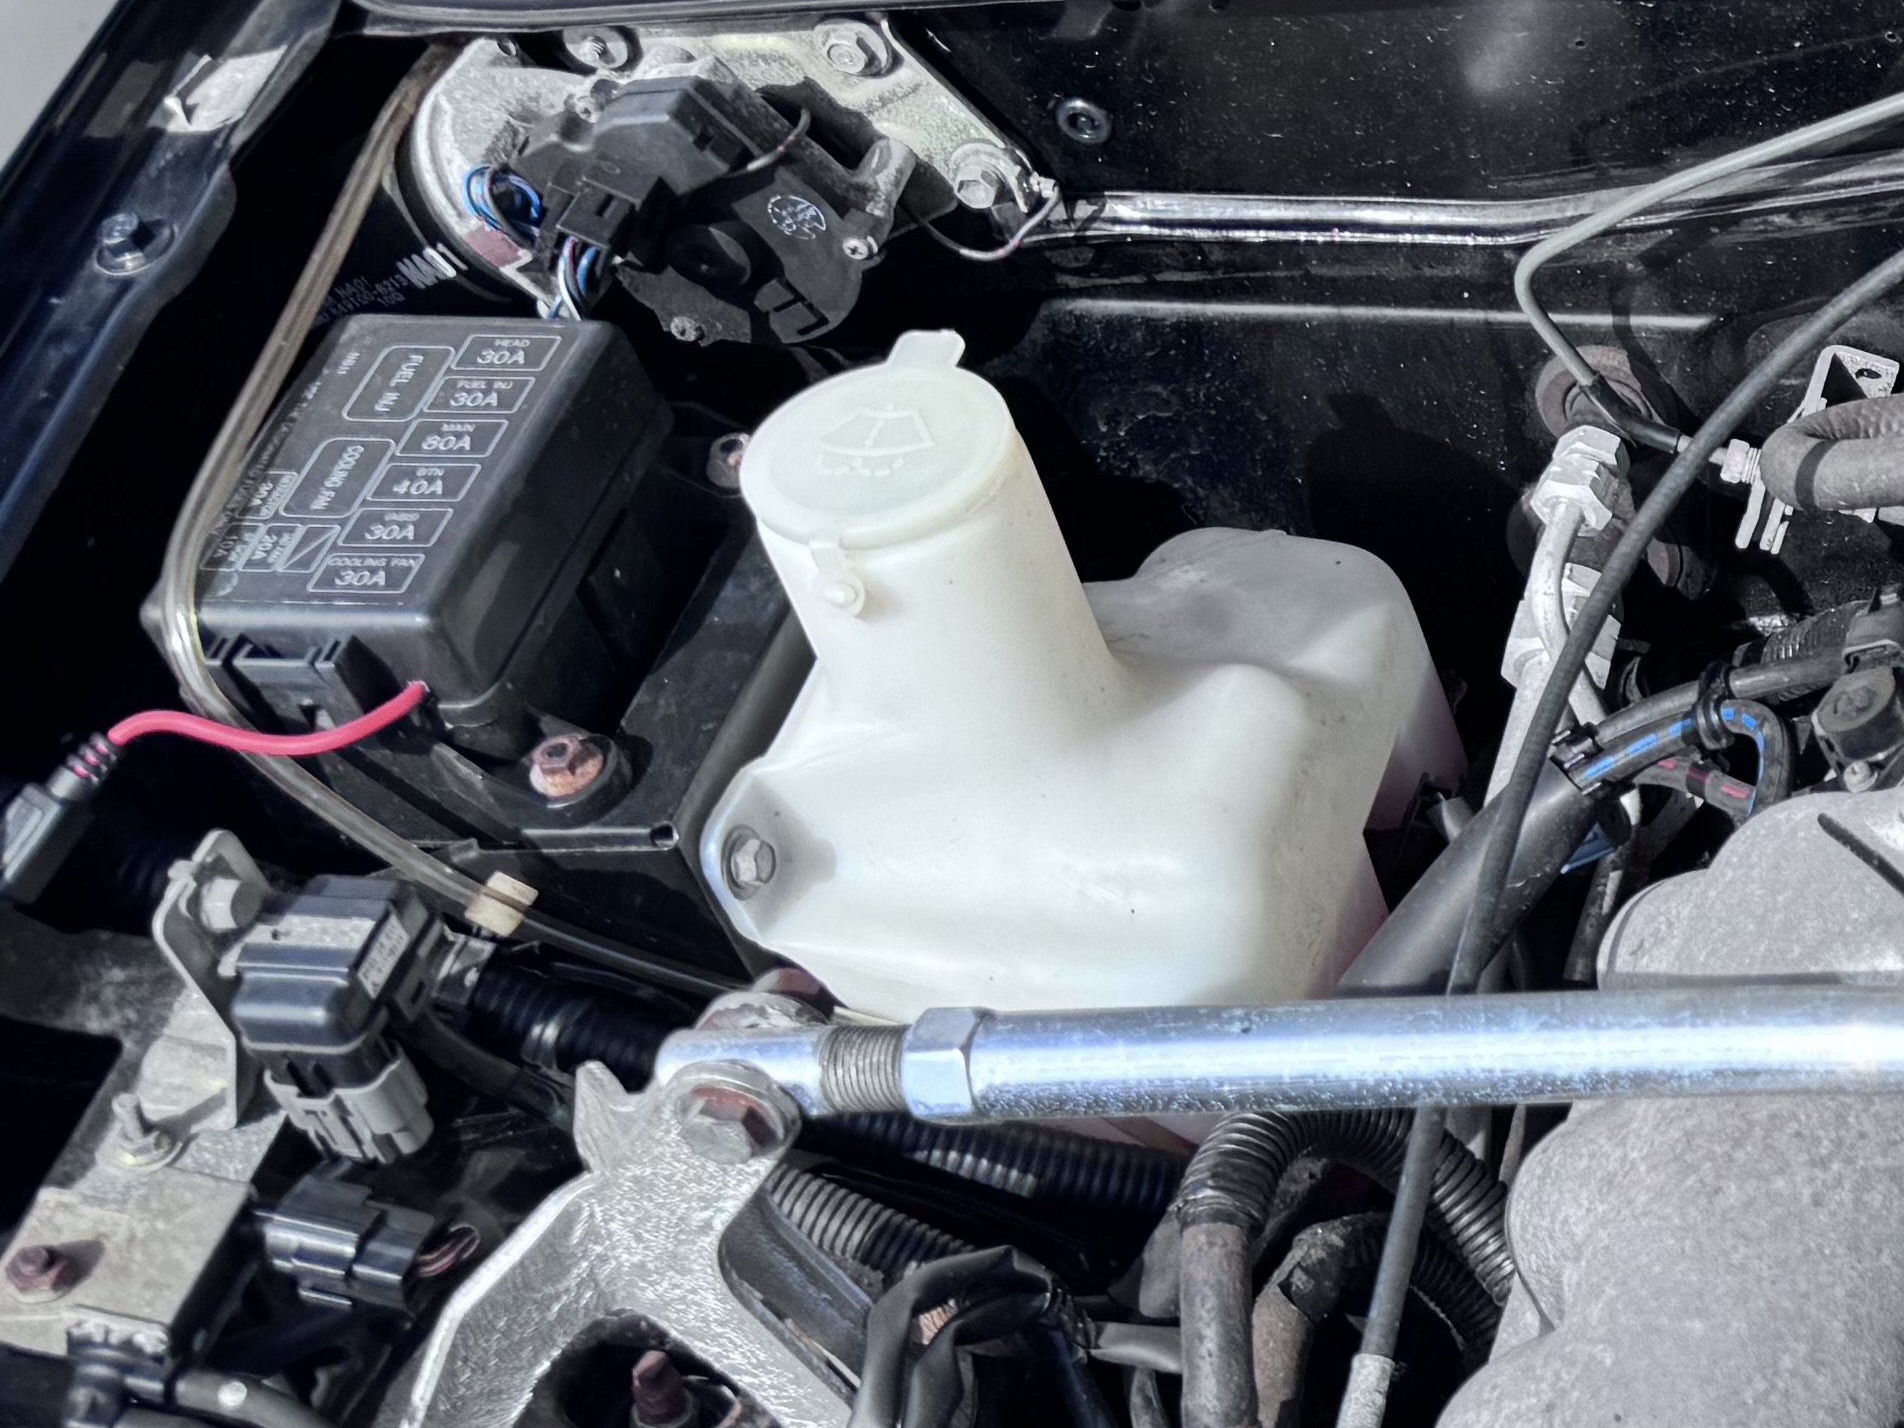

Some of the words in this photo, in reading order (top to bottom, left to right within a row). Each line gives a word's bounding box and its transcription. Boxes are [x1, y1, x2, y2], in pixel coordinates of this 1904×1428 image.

[476, 348, 525, 365] 30A
[389, 354, 425, 388] FUEL
[449, 391, 499, 407] 30A
[392, 478, 443, 495] 40A
[363, 522, 415, 541] 30A
[333, 569, 386, 587] 30A
